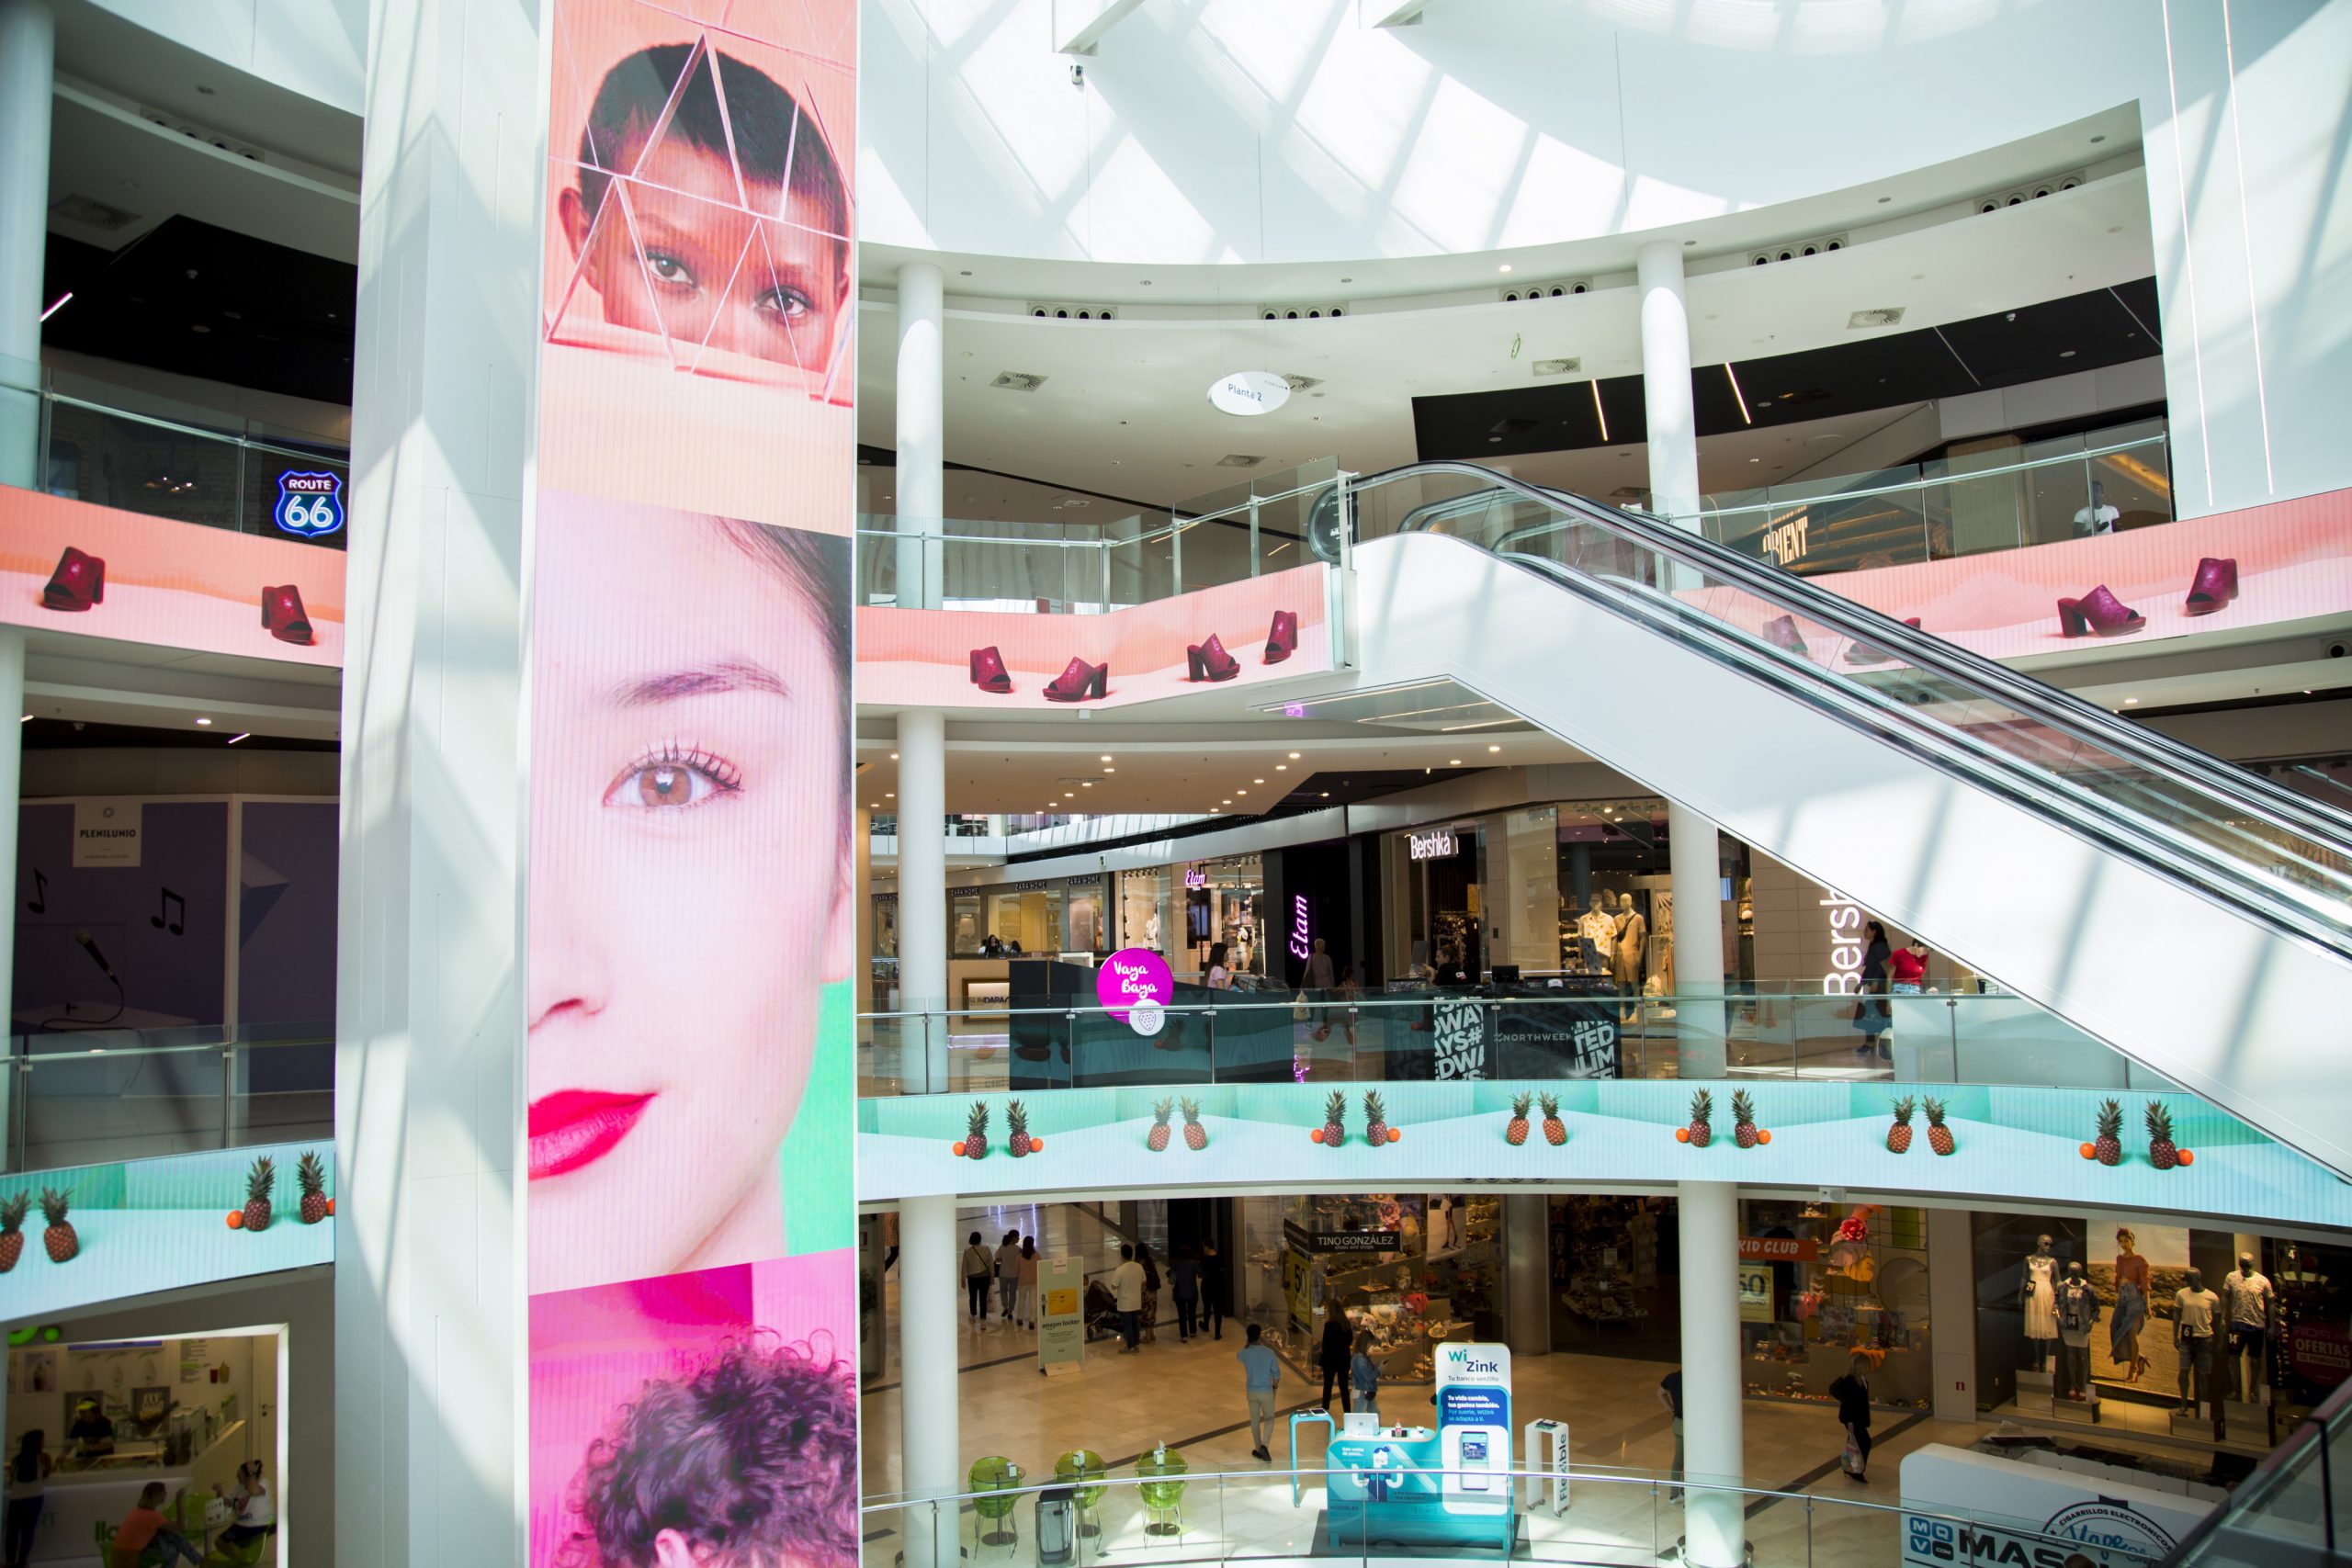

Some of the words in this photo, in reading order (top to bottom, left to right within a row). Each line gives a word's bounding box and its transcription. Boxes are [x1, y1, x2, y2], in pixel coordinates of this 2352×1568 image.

[1227, 382, 1255, 400] Planta
[1257, 391, 1262, 402] 2
[288, 479, 332, 491] ROUTE
[285, 494, 334, 528] 66
[80, 829, 136, 838] PLENILUNIO
[1410, 831, 1452, 860] Bershka
[1185, 869, 1206, 886] Etam
[1290, 895, 1309, 960] Etam
[1114, 961, 1149, 982] Vaya
[1121, 979, 1159, 999] Baya
[1317, 1236, 1342, 1246] TINO
[1342, 1234, 1395, 1246] GONZÁLEZ
[1763, 1241, 1799, 1255] CLUB
[1448, 1349, 1467, 1361] Wi
[2295, 1338, 2349, 1358] OFERTAS
[1466, 1359, 1498, 1372] Zink
[2059, 1508, 2109, 1526] CIGARRILLOS
[2109, 1510, 2174, 1552] ELECTRONICOS
